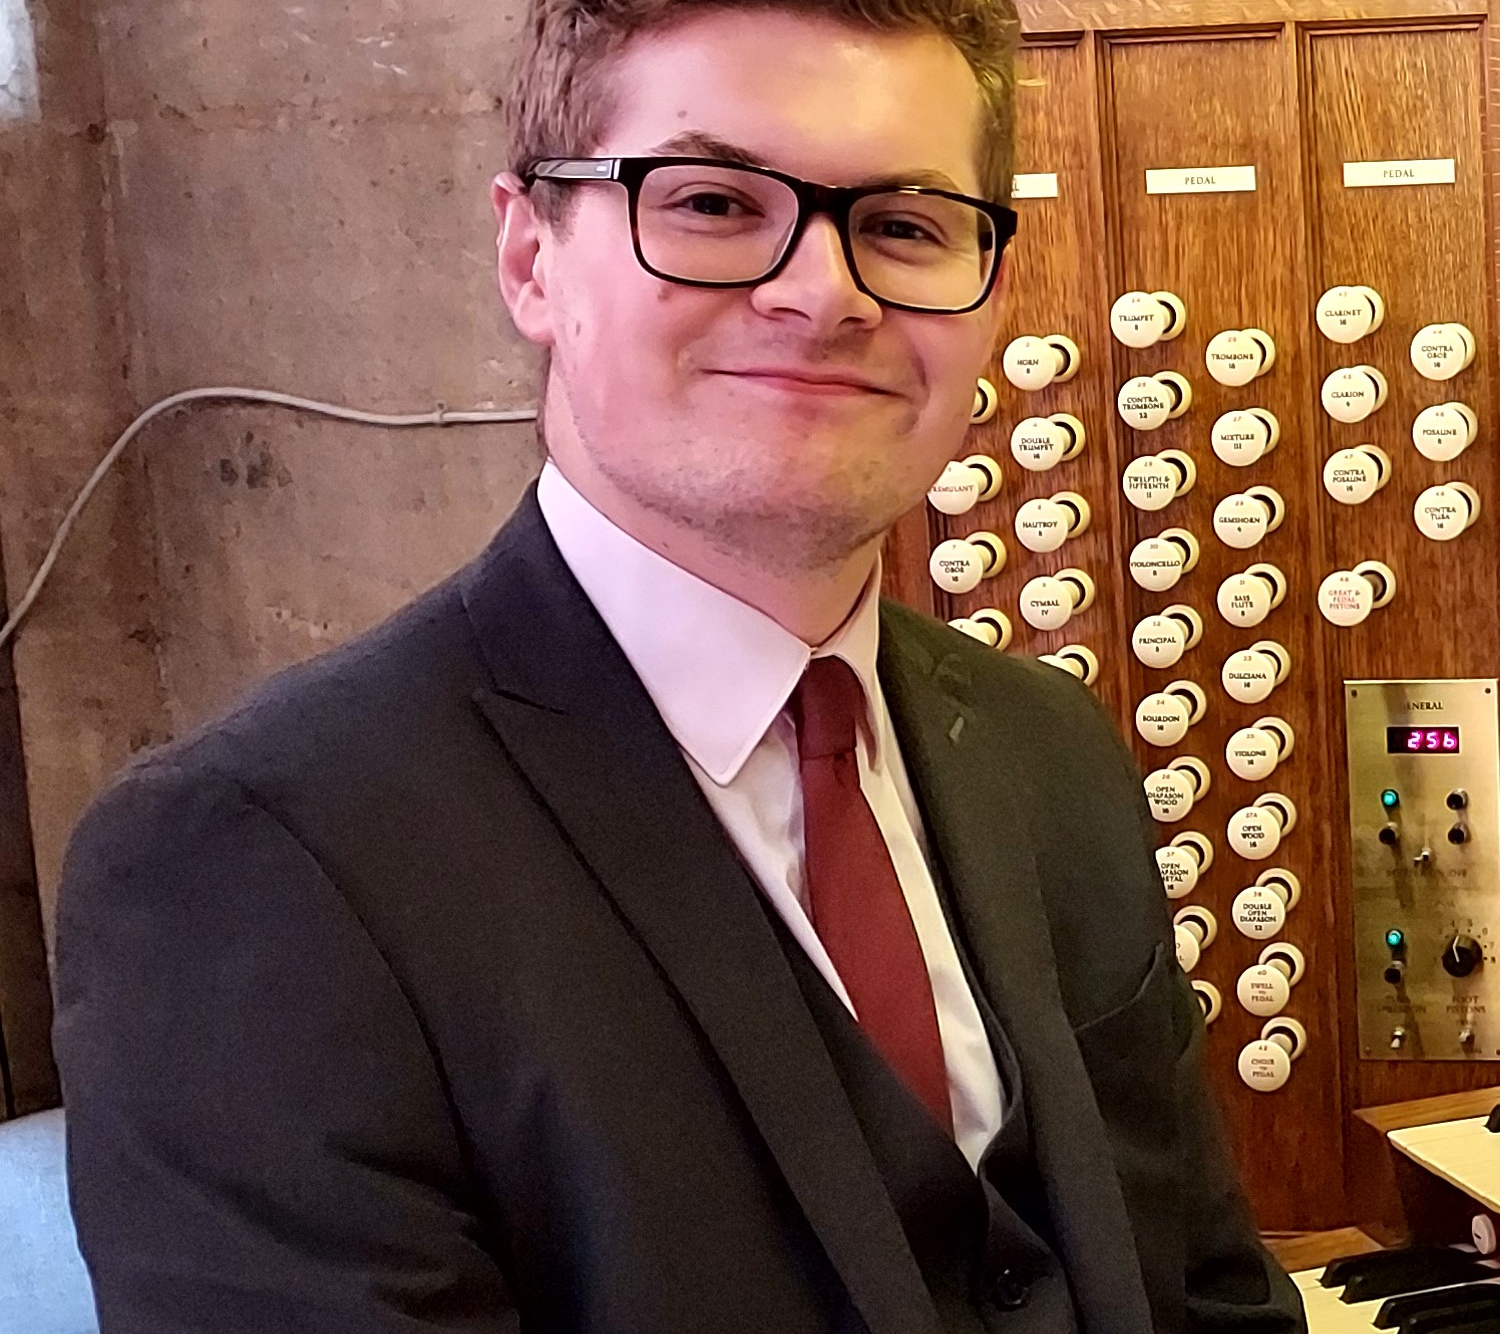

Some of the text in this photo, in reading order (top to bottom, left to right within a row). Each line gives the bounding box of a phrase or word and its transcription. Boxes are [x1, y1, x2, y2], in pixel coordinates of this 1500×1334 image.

[1382, 168, 1415, 179] PEDAL
[1184, 175, 1216, 186] PEDAL
[1325, 309, 1362, 317] CLARINET
[1211, 353, 1254, 361] TROMBONE
[1130, 560, 1180, 568] VIOLONCELLO
[1231, 601, 1254, 609] FLUTE
[1147, 792, 1184, 800] DIAPASON
[1248, 909, 1267, 917] OPEN
[1251, 1058, 1275, 1066] CHOIR
